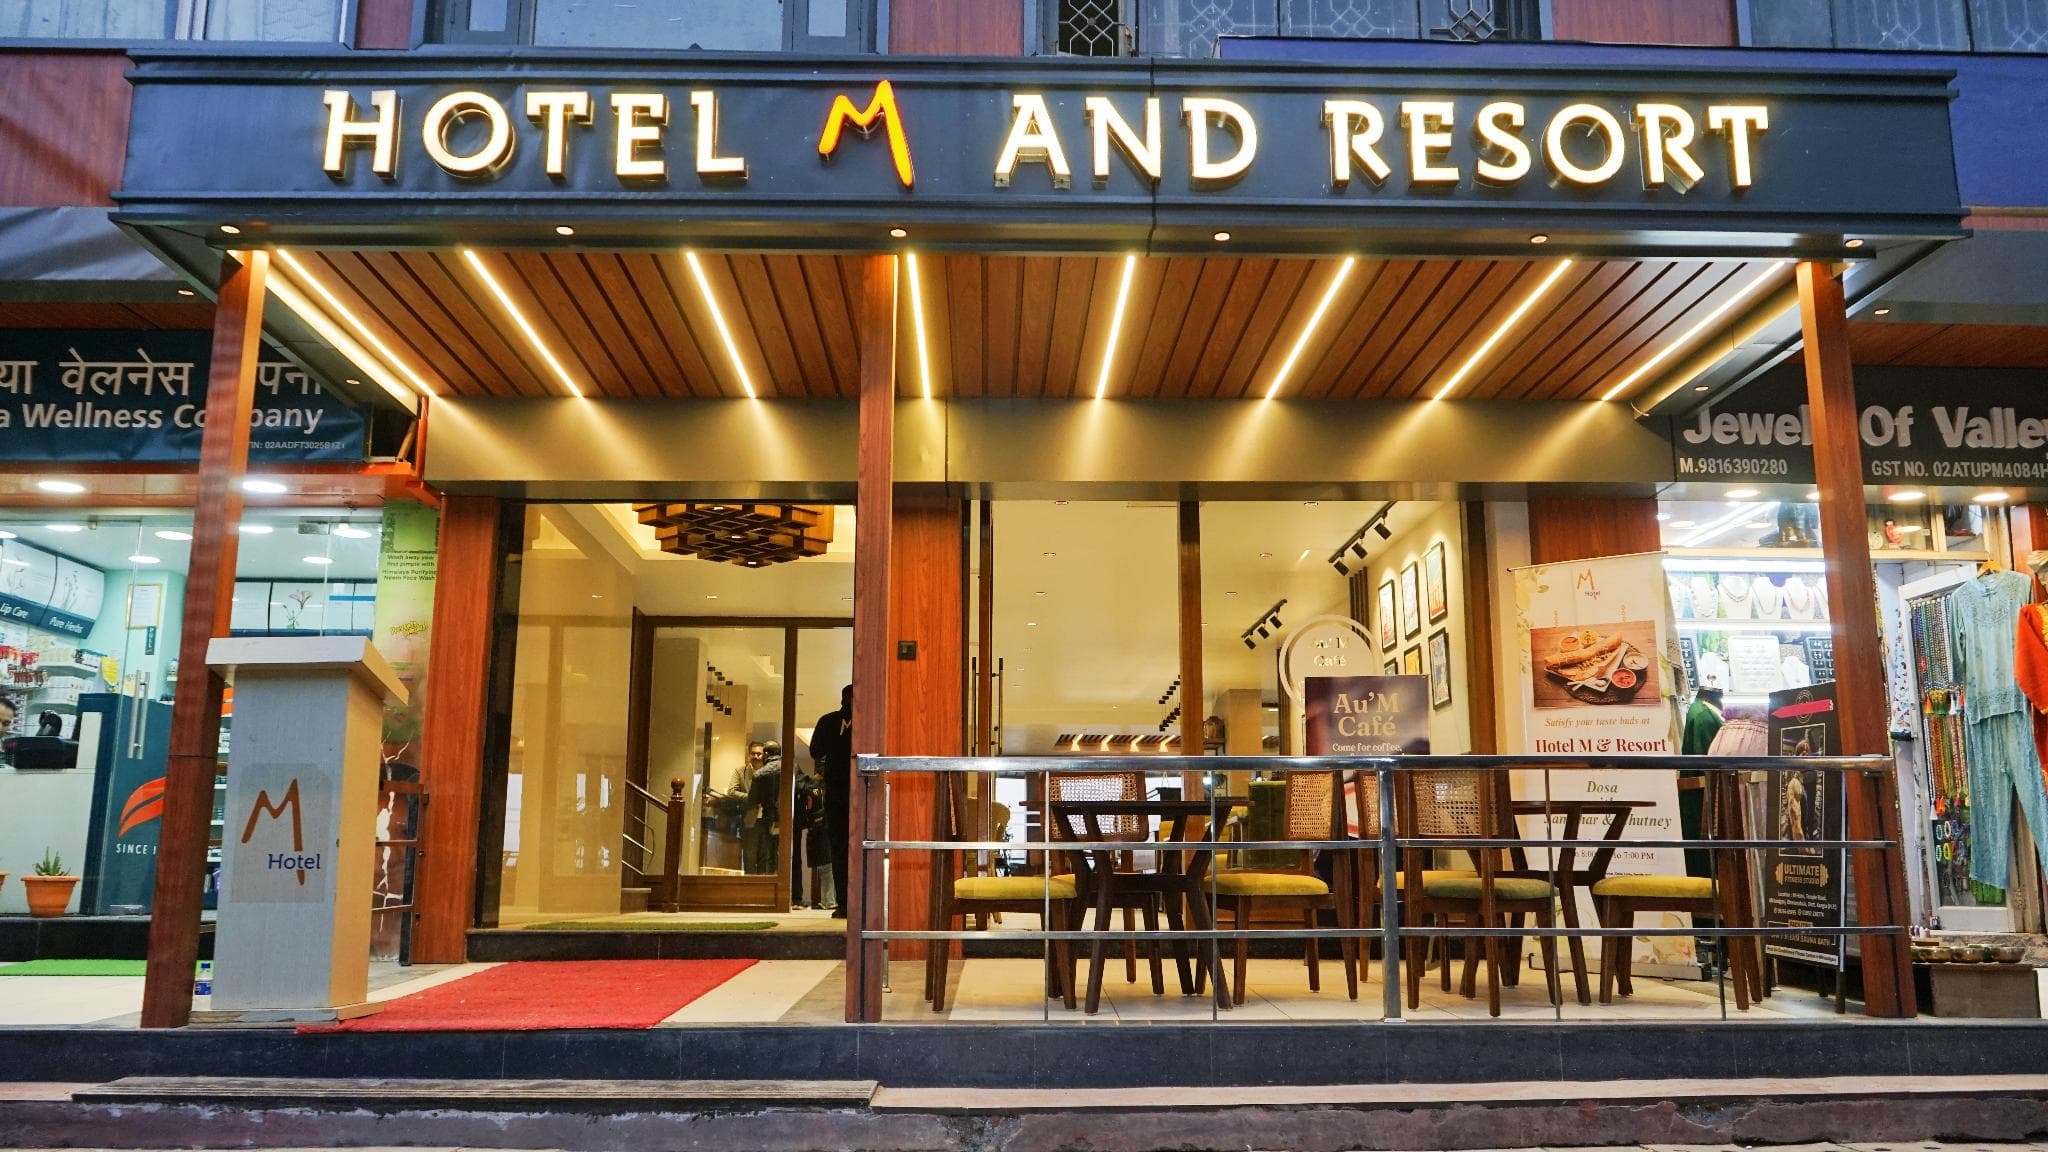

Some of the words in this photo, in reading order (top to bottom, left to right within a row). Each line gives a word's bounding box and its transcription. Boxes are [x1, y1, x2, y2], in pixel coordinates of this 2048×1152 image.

[323, 90, 748, 180] HOTEL
[818, 80, 914, 190] M
[994, 93, 1258, 188] AND
[1323, 99, 1768, 191] RESORT
[58, 346, 195, 396] वेलनेस
[22, 402, 163, 429] Wellness
[173, 403, 324, 435] Copany
[1859, 404, 1913, 448] Of
[1679, 457, 1788, 475] M.9816390280
[1872, 460, 1900, 476] GST
[1904, 462, 1929, 477] NO.
[1337, 715, 1397, 737] Café
[1545, 717, 1573, 729] Satisfy
[1575, 718, 1593, 728] your
[1596, 716, 1617, 726] taste
[1619, 715, 1639, 726] buds
[1641, 716, 1651, 725] at
[1332, 743, 1356, 752] Come
[1357, 743, 1372, 752] for
[1535, 738, 1575, 753] Hotel
[1579, 738, 1593, 753] M
[1596, 737, 1611, 753] &
[1616, 737, 1668, 753] Resort
[1586, 780, 1618, 793] Dosa
[1626, 812, 1672, 830] hutney
[116, 843, 148, 855] SINCE
[1641, 852, 1654, 860] PM
[268, 853, 321, 870] Hotel
[1784, 863, 1820, 877] ULTIMATE
